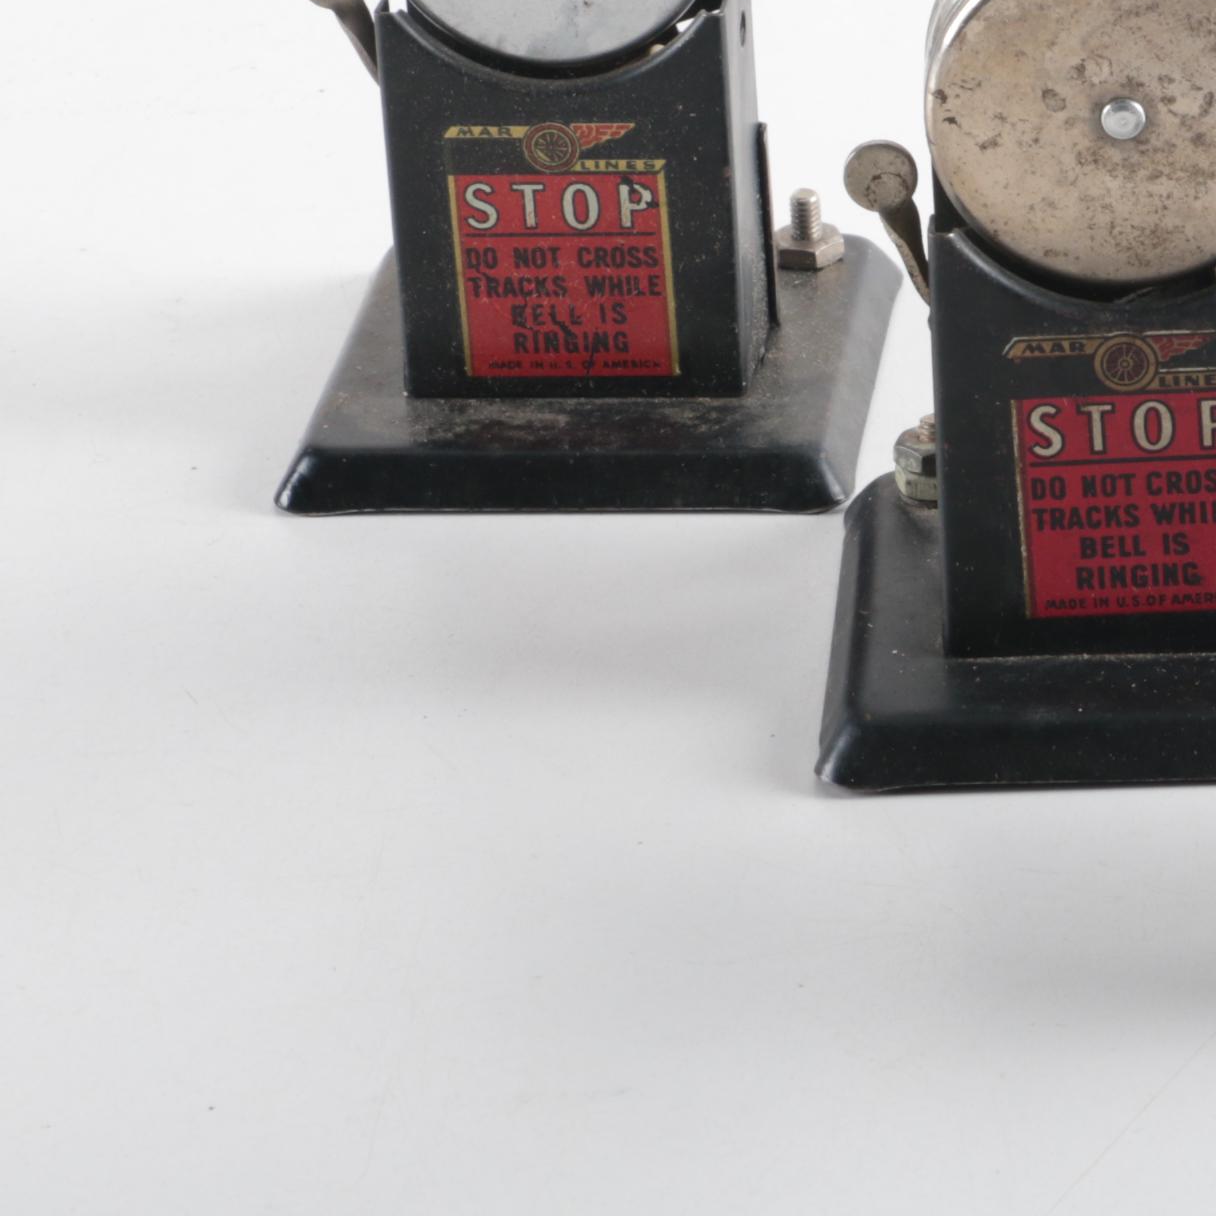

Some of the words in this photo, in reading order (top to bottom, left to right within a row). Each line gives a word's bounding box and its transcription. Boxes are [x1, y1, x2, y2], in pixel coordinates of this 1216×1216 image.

[456, 127, 513, 137] MAR
[579, 160, 657, 171] LINES
[464, 181, 654, 231] STOP
[465, 247, 498, 269] DO
[513, 247, 560, 269] NOT
[577, 246, 659, 269] CROSS
[466, 276, 568, 298] TRACKS
[584, 275, 662, 297] WHILE
[511, 304, 582, 326] BELL
[600, 303, 628, 324] IS
[513, 333, 629, 354] RINGING
[1022, 340, 1087, 354] MAR
[530, 360, 544, 370] IN
[1030, 475, 1067, 501] DO
[1082, 473, 1136, 498] NOT
[1032, 503, 1141, 531] TRACKS
[1079, 535, 1146, 560] BELL
[1162, 532, 1191, 557] IS
[1075, 562, 1203, 590] RINGING
[1044, 598, 1087, 611] MADE
[1093, 597, 1110, 609] IN
